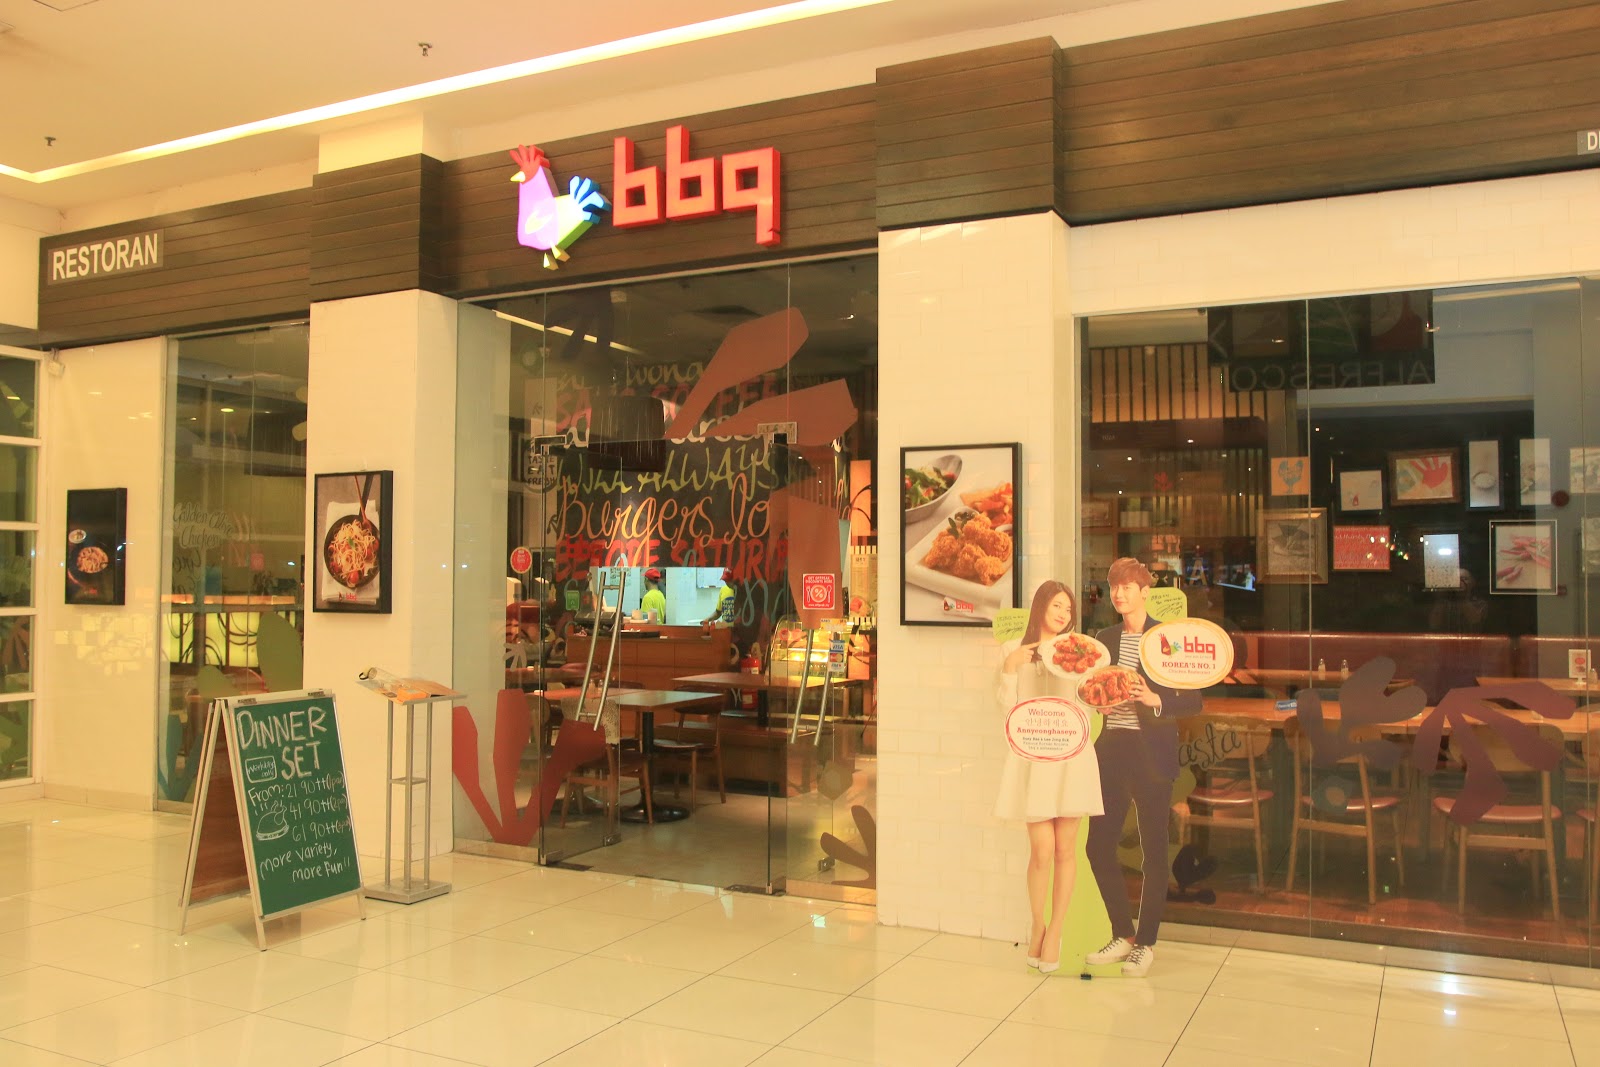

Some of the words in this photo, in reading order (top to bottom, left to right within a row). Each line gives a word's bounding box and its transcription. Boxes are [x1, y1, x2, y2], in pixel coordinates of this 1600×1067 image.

[1587, 130, 1600, 151] D
[612, 125, 781, 246] bbq
[52, 233, 158, 281] RESTORAN
[556, 474, 715, 563] Burgers
[955, 601, 975, 613] bbq
[1183, 636, 1216, 660] bbq
[1162, 661, 1196, 669] KOREA'S
[1197, 662, 1211, 670] NO.
[1024, 718, 1069, 728] 안녕하세요
[1027, 708, 1066, 718] Welcome
[237, 706, 327, 750] DINNER
[1016, 727, 1077, 736] Annyeonghaseyo
[1178, 722, 1242, 769] asta
[281, 741, 320, 780] SET
[248, 784, 285, 807] From:
[287, 783, 298, 799] 21
[289, 802, 302, 820] 41
[292, 825, 306, 842] 61
[259, 850, 292, 880] more
[292, 864, 322, 883] more
